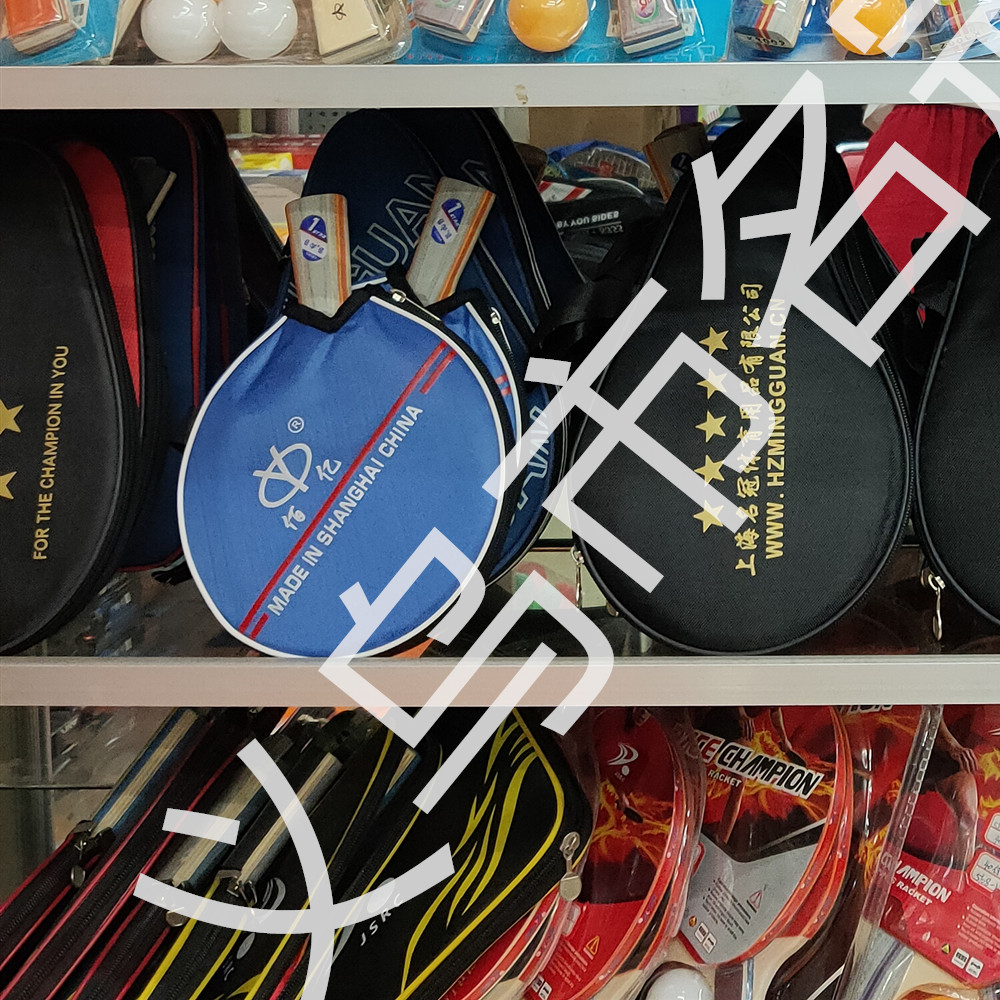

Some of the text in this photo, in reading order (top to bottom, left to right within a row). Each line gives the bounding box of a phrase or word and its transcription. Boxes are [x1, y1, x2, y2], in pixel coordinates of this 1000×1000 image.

[307, 216, 316, 231] 1
[447, 201, 460, 217] 1
[32, 345, 69, 561] FOR THE CHAMPION IN YOU
[734, 282, 763, 578] 上海名冠体育用品有限公司
[764, 298, 787, 561] WWW.HZMINGGUAN.CN
[266, 405, 424, 617] MADE IN SHANGHAI CHINA
[708, 769, 743, 788] RACKET
[712, 736, 824, 799] CHAMPION
[895, 879, 933, 907] RACKET
